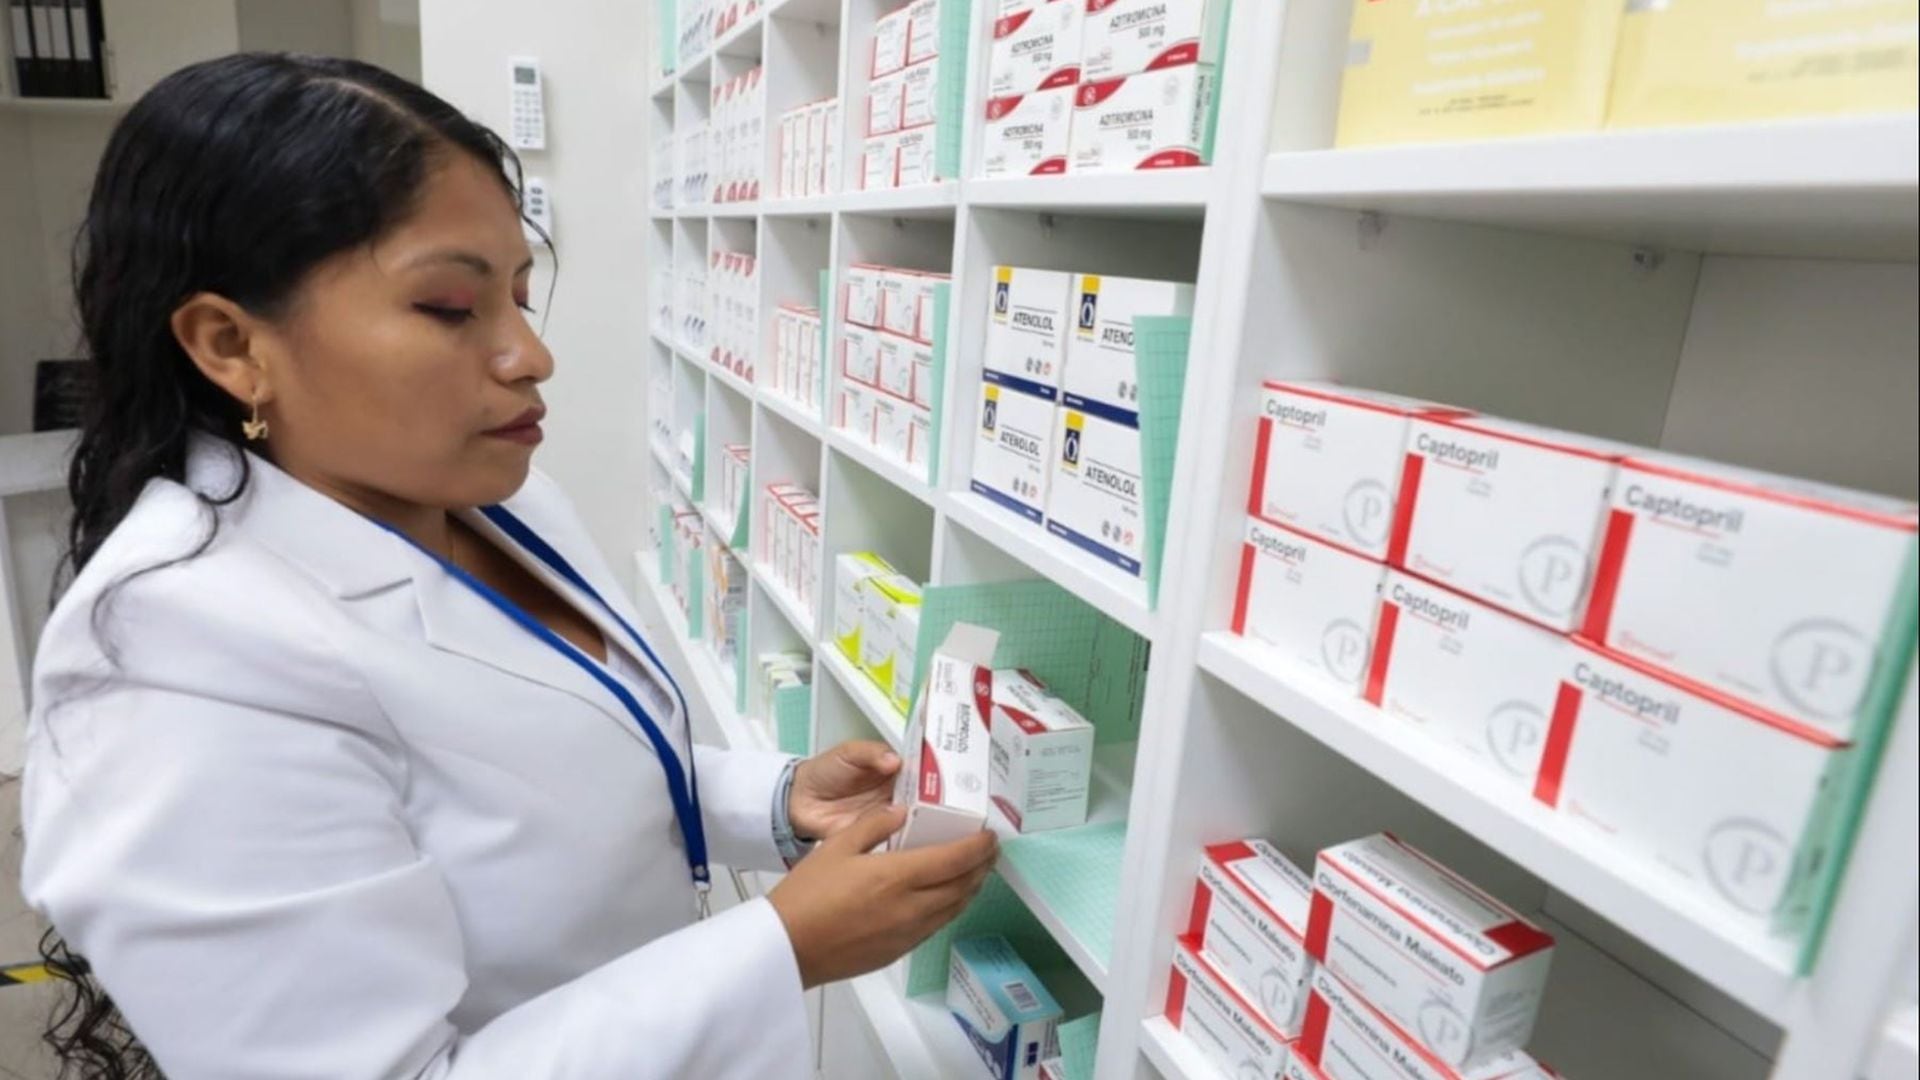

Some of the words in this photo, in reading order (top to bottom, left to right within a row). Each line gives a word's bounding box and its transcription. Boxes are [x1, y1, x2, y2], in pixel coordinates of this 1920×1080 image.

[1013, 312, 1054, 331] ATENOLOL
[1267, 398, 1327, 427] Captopril
[1000, 431, 1041, 456] ATENOLOL
[1416, 432, 1499, 469] Captopril
[1085, 466, 1138, 497] ATENOLOL
[1625, 484, 1744, 534] Captopril
[1250, 526, 1307, 562] Captopril
[1392, 584, 1470, 629] Captopril
[1573, 661, 1681, 726] Captopril
[1257, 918, 1296, 962] Maleato
[1318, 872, 1402, 943] Clorfenamina
[1404, 934, 1466, 986] Maleato
[1233, 1010, 1273, 1057] Maleato
[1318, 975, 1392, 1054] Clorfenamina
